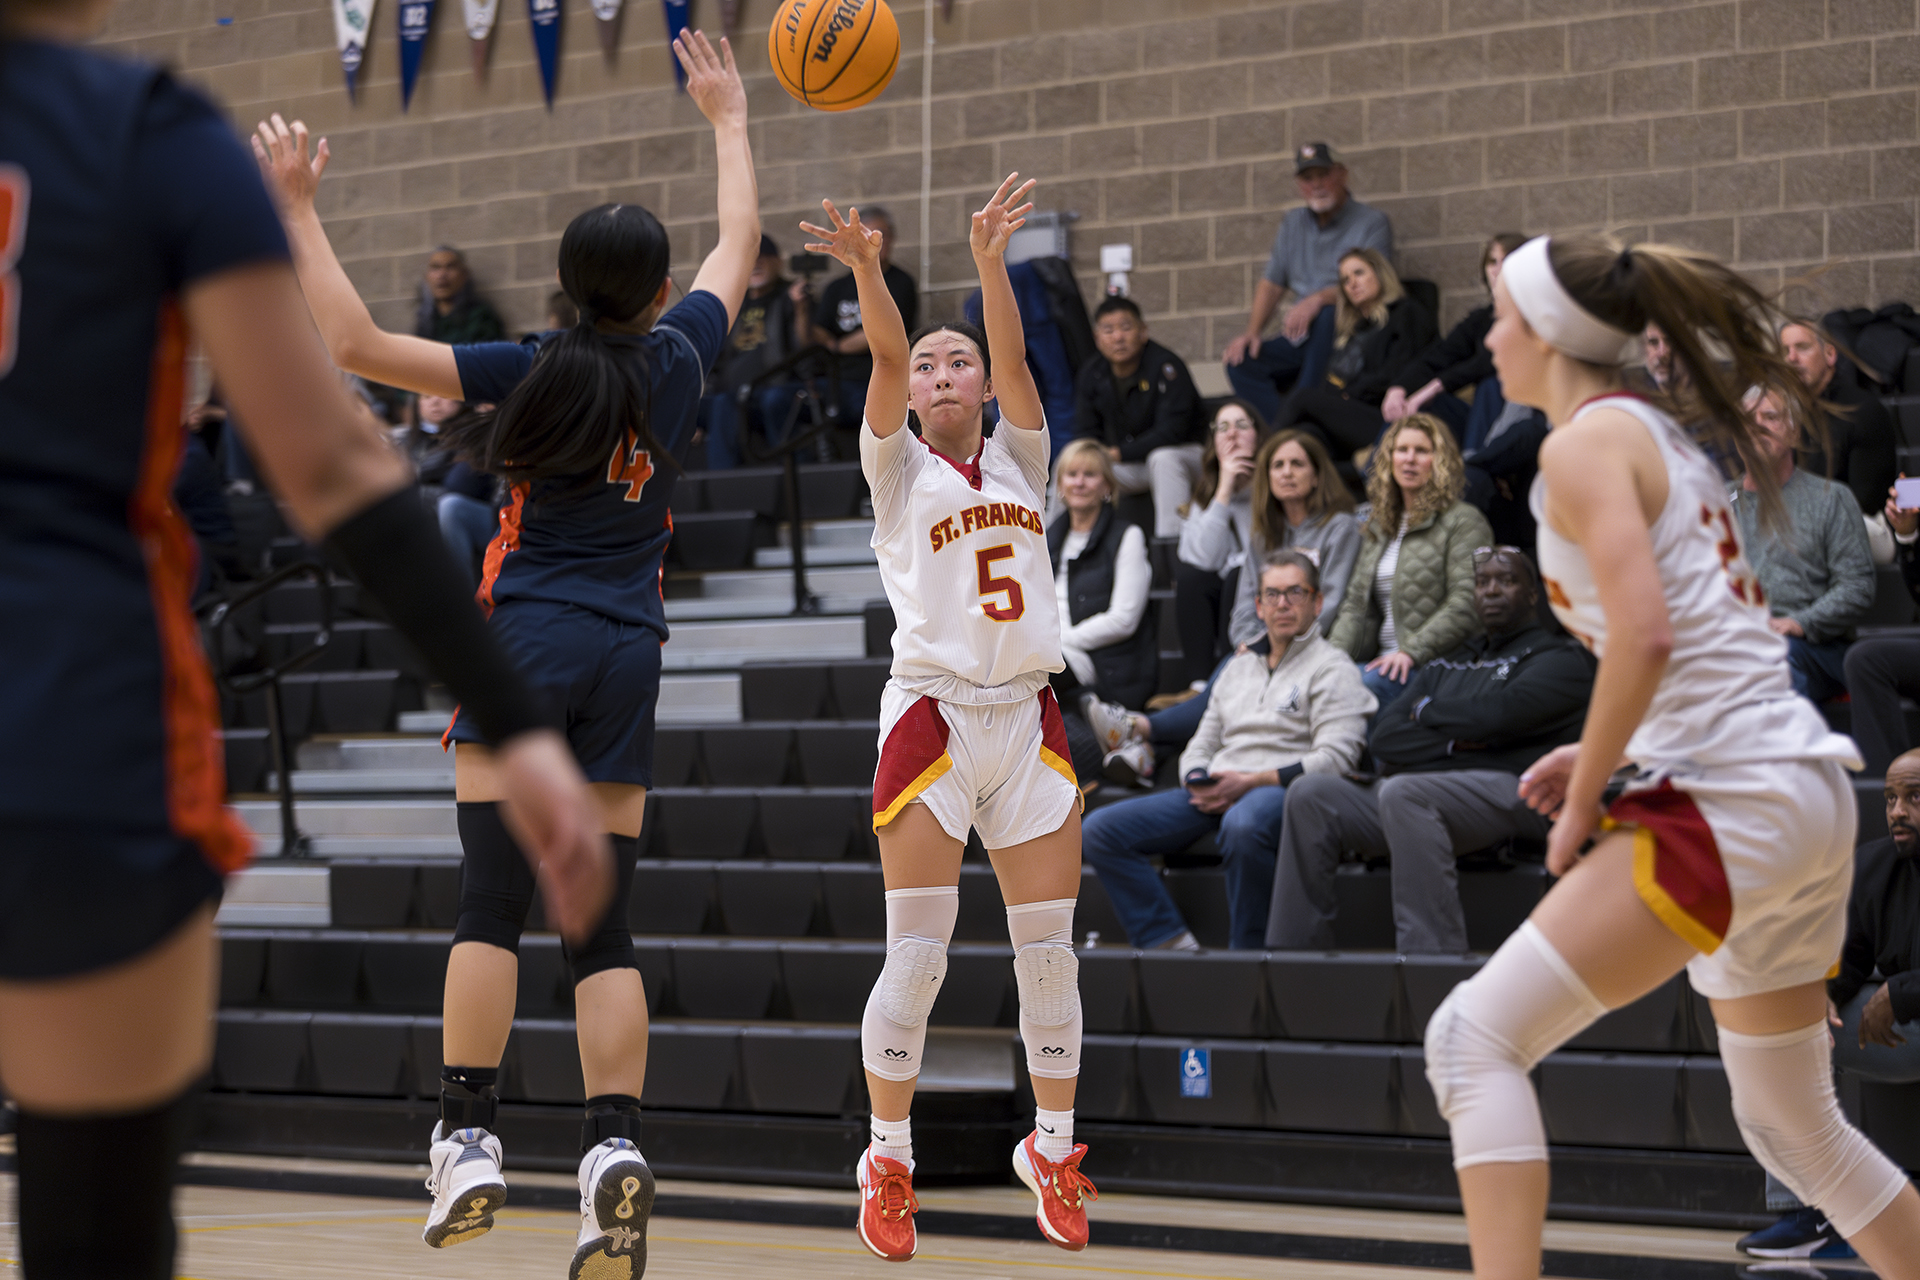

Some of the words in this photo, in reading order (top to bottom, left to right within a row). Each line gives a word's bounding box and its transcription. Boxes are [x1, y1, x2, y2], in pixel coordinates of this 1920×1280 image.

[607, 424, 654, 502] 4
[929, 515, 960, 554] ST.
[960, 502, 1044, 536] FRANCIS
[975, 543, 1025, 622] 5
